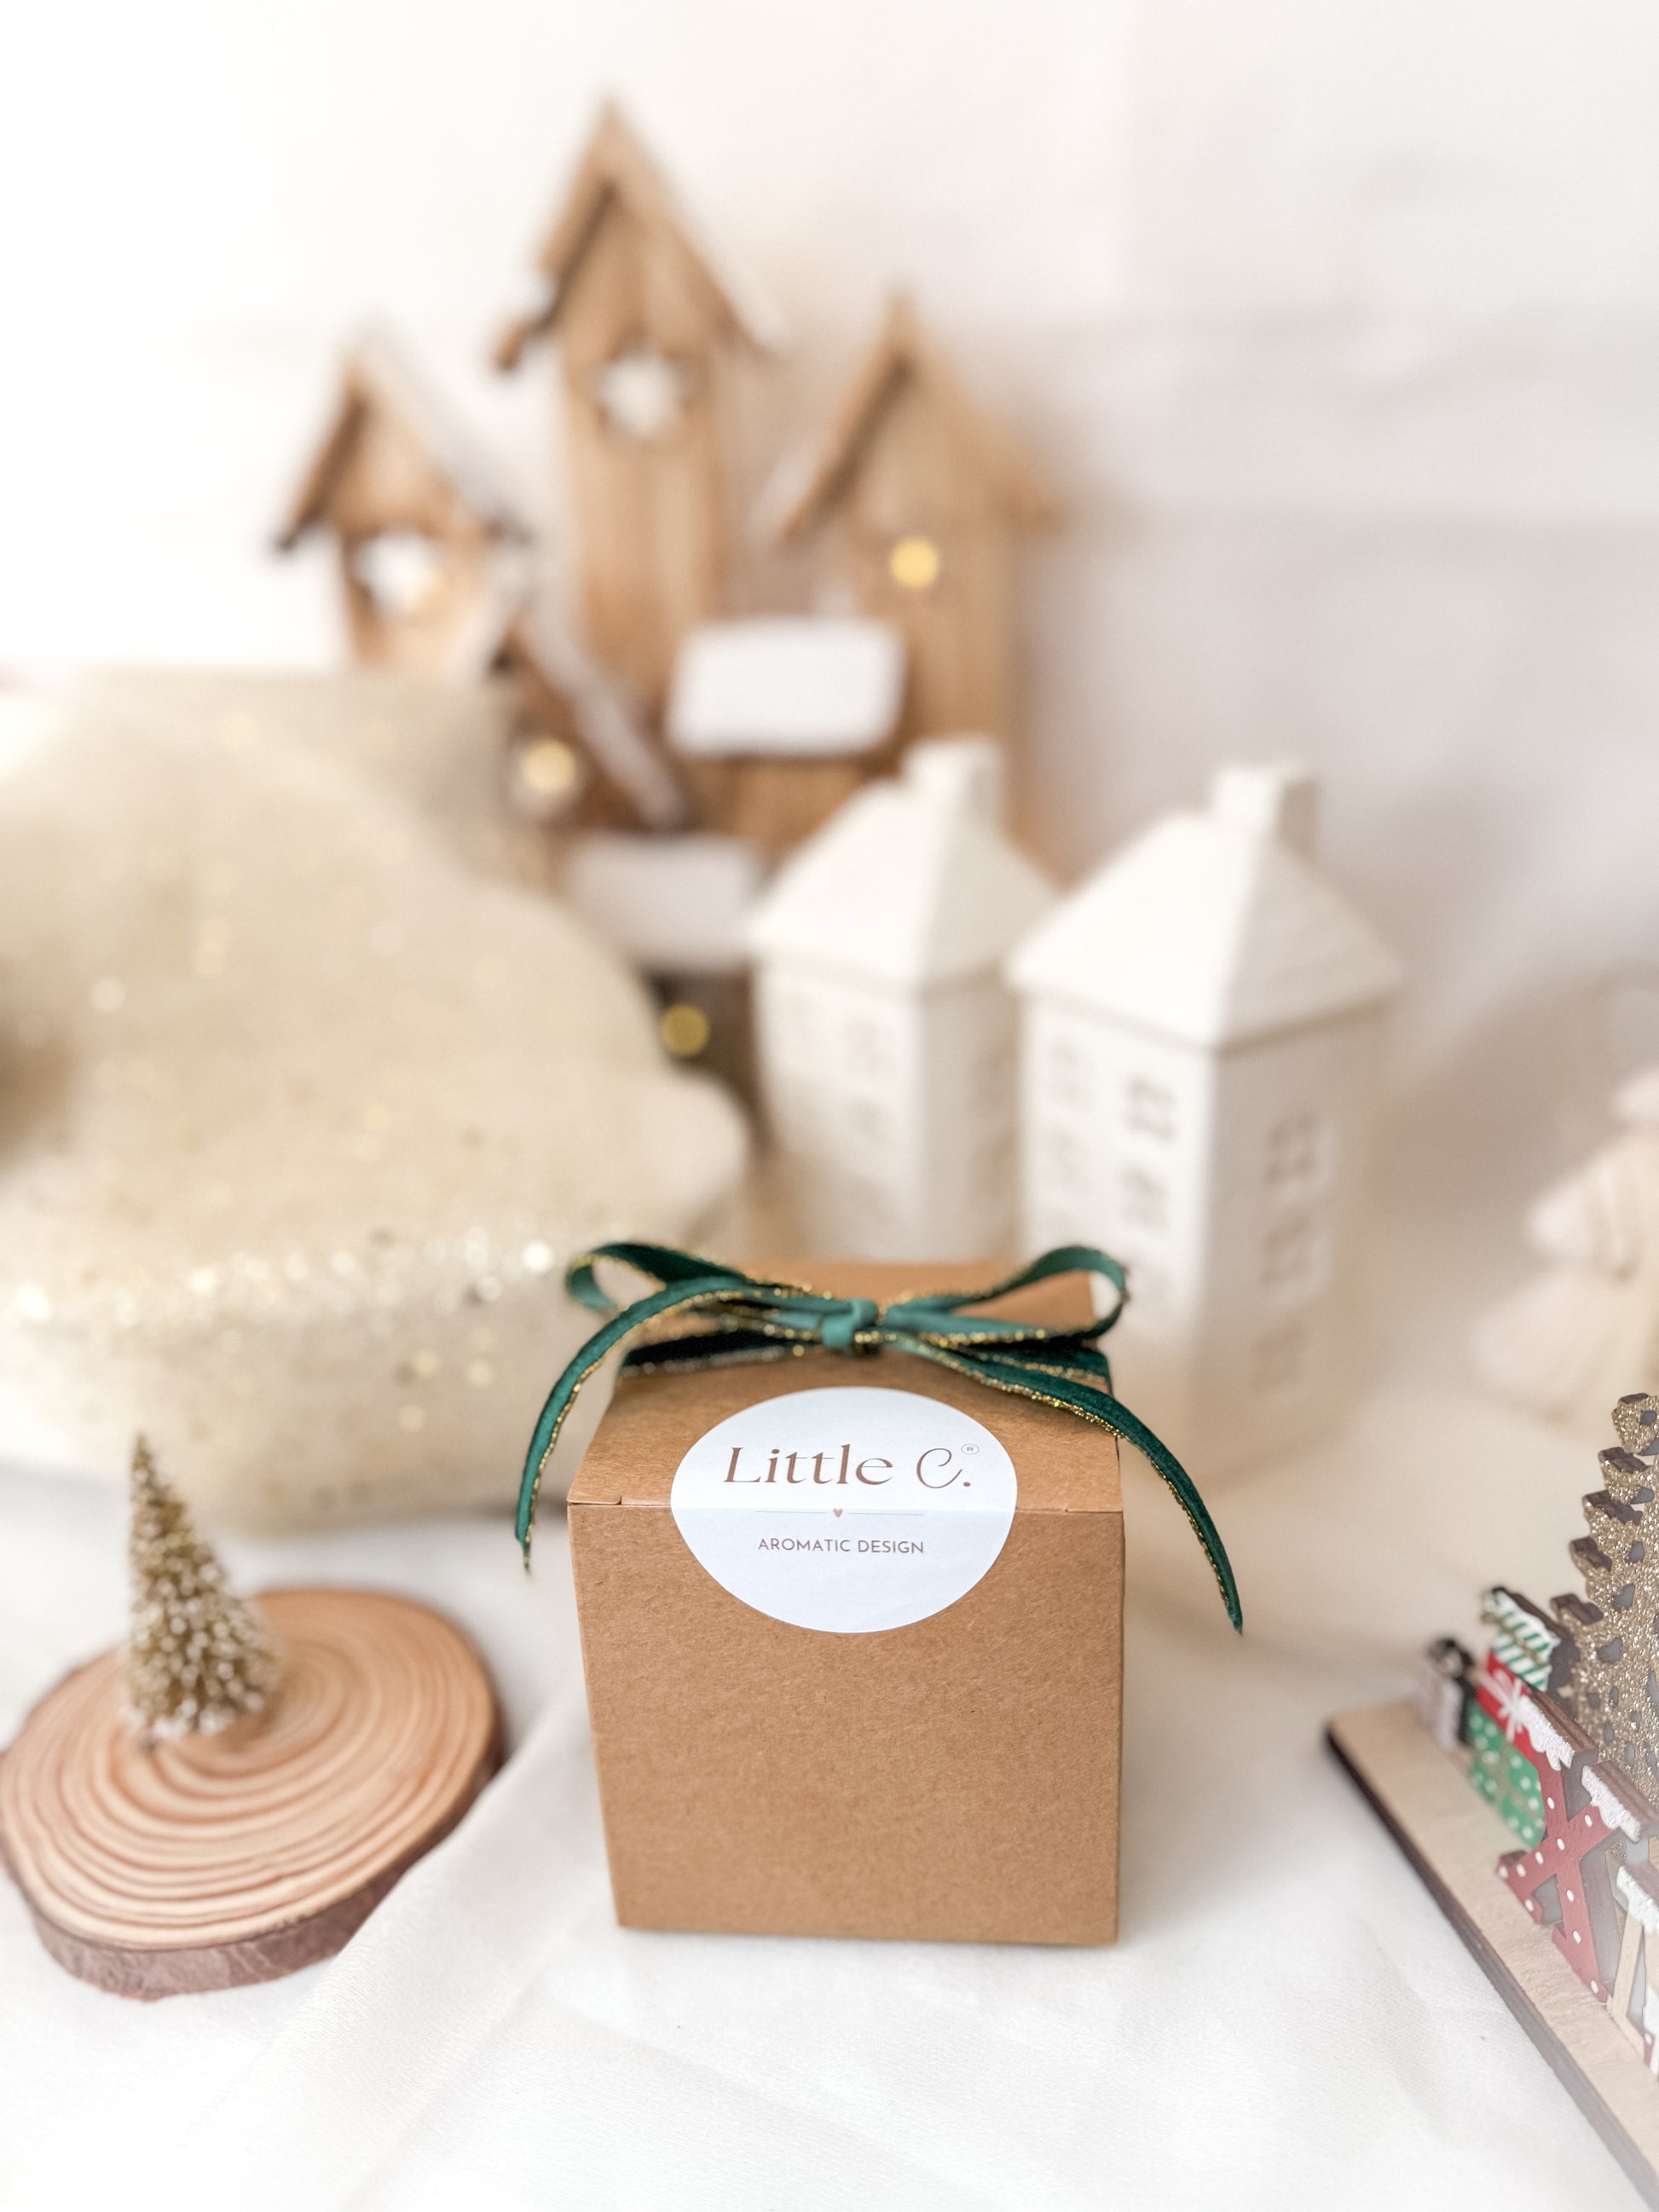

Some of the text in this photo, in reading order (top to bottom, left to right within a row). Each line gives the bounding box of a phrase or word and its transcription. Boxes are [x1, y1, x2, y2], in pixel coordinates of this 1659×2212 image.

[723, 1443, 893, 1486] Little
[757, 1537, 924, 1554] AROMATIC DESIGN
